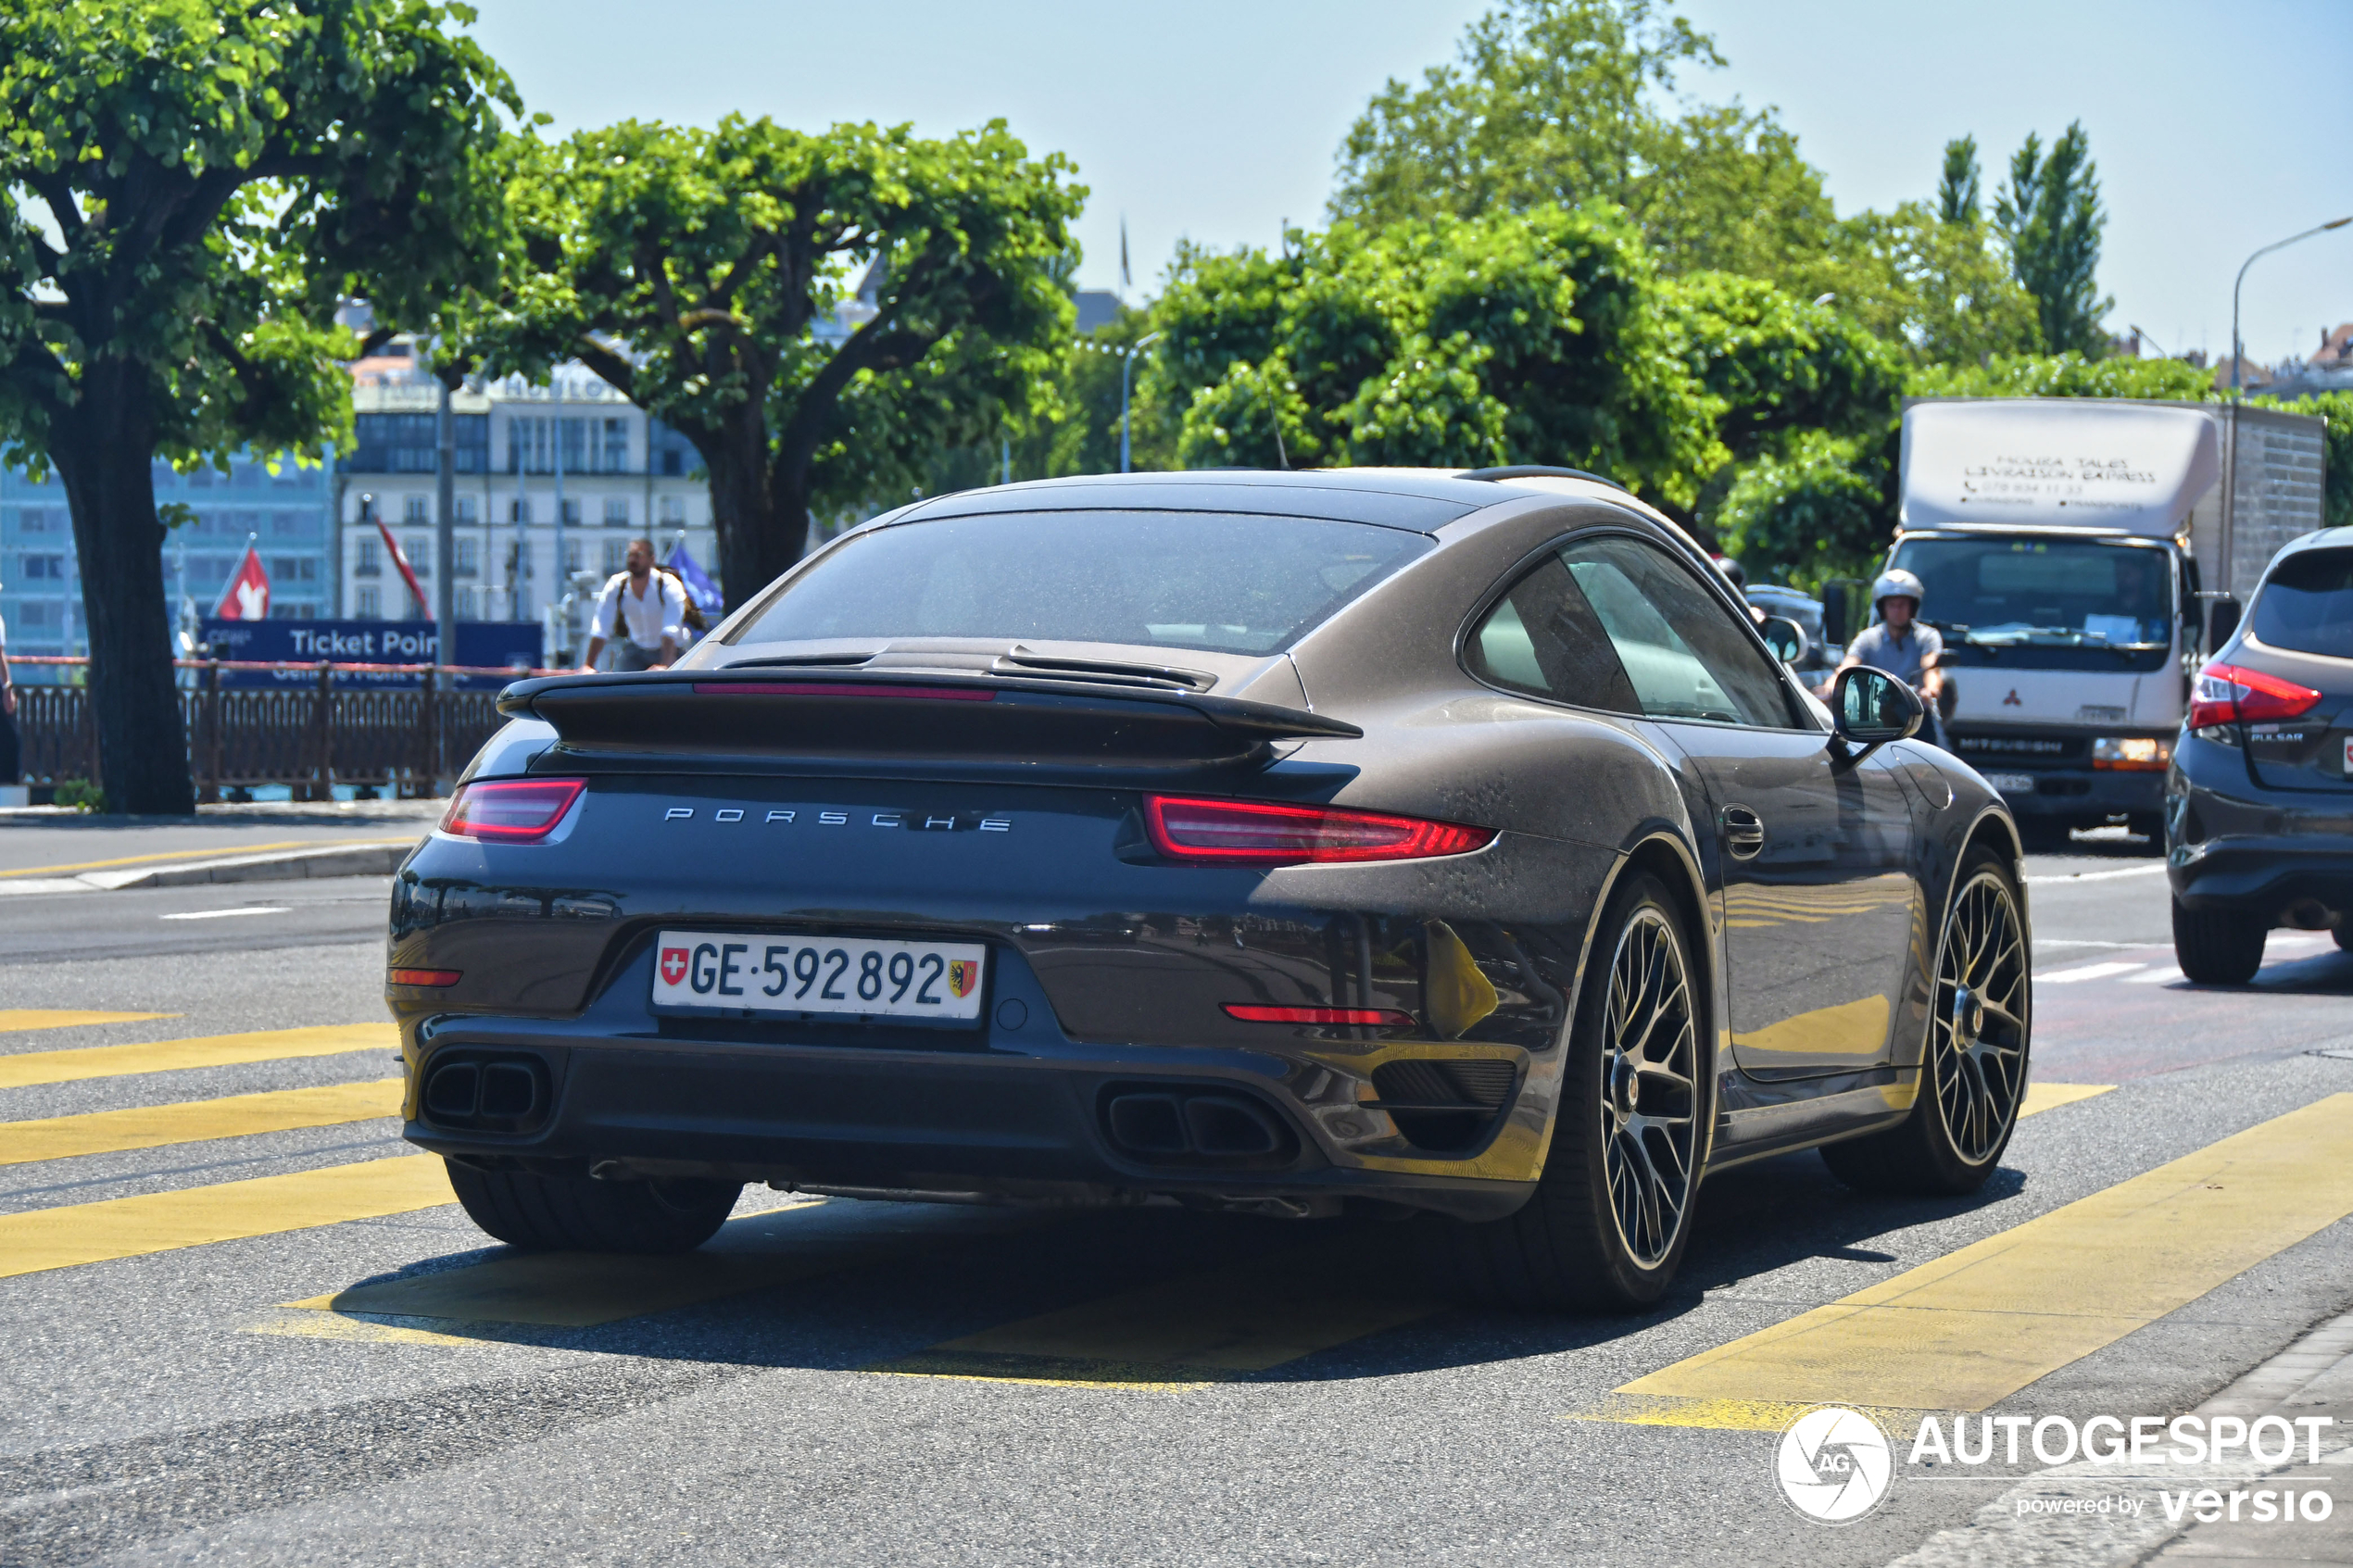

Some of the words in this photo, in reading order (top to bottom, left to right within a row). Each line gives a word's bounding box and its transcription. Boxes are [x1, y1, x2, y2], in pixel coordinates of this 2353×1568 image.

[1965, 467, 2073, 479] LIVRAISON
[2082, 471, 2157, 483] EXPRESS
[289, 630, 374, 656] Ticket
[382, 631, 441, 657] Poin
[2251, 733, 2304, 743] PULSAR
[664, 808, 1012, 833] PORSCHE
